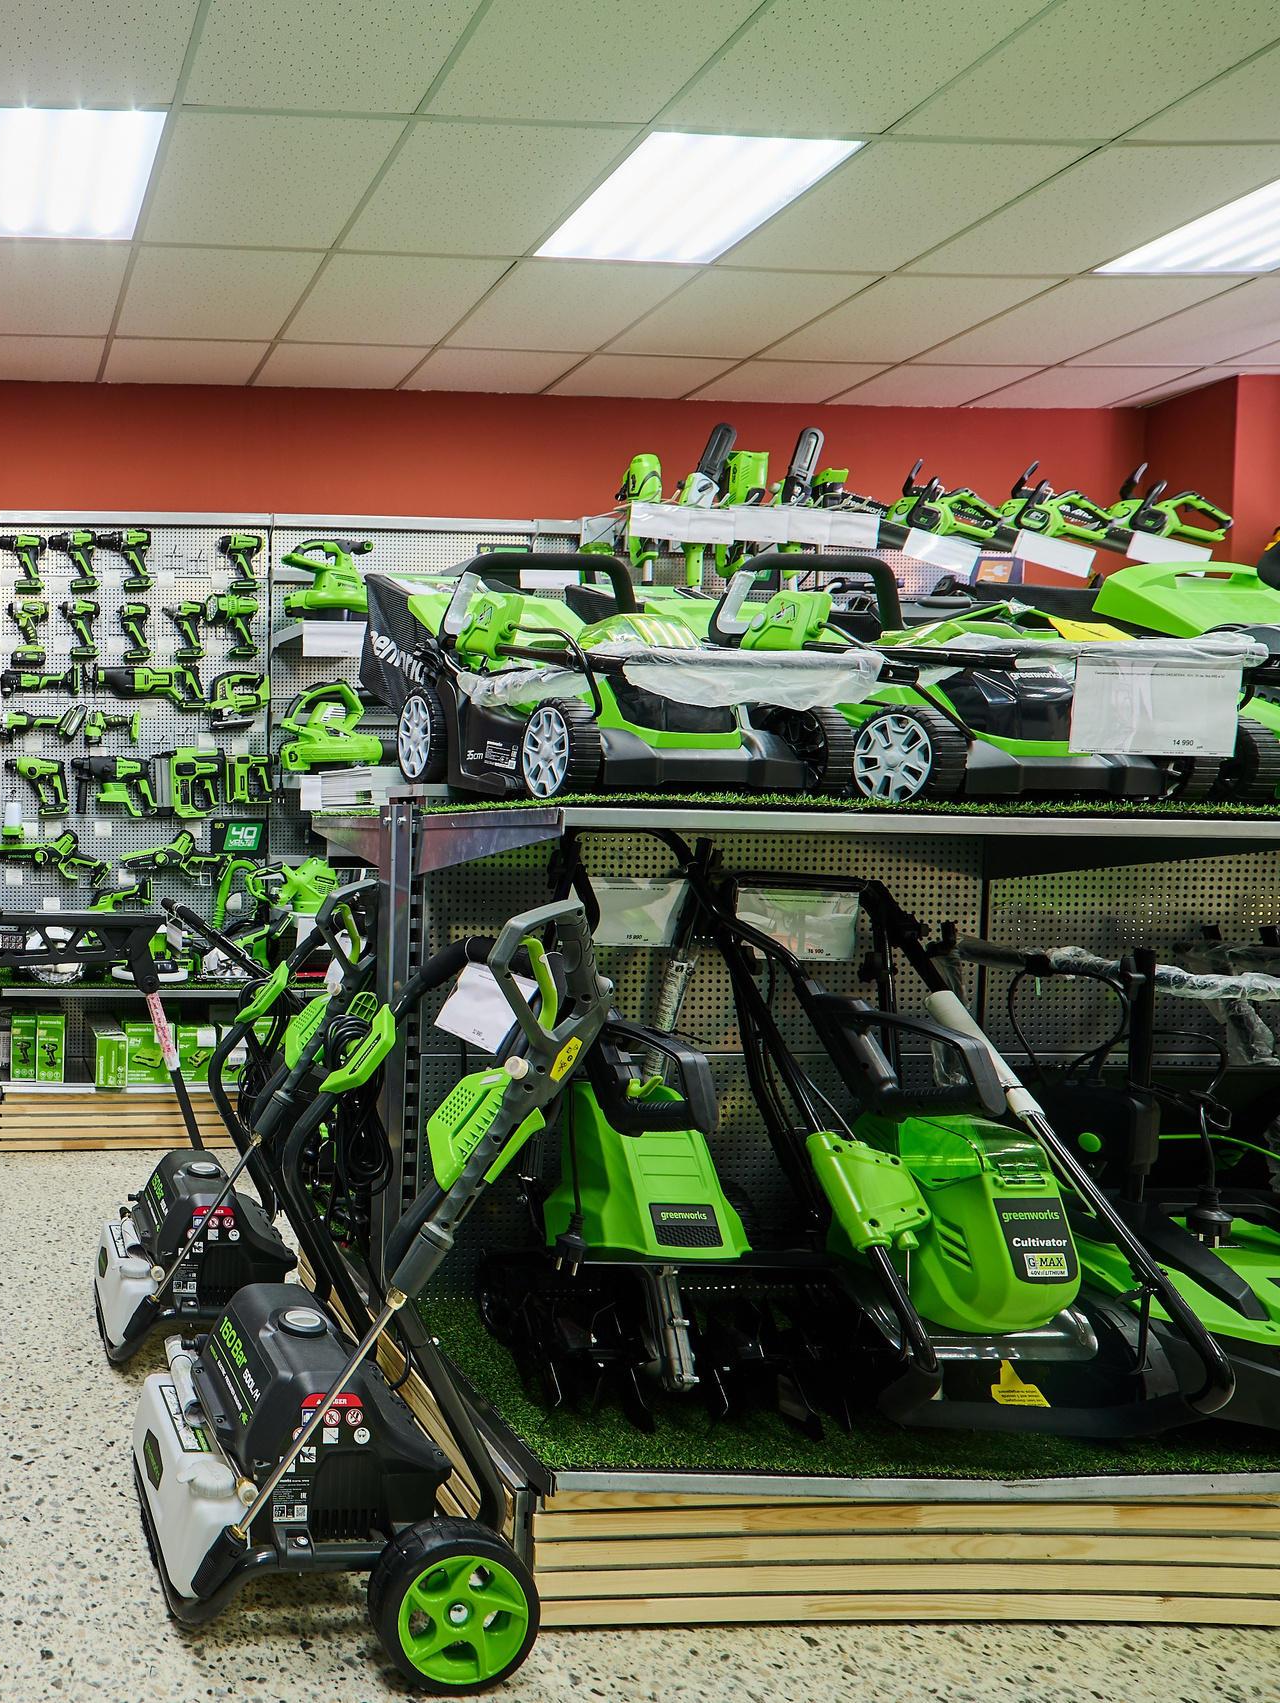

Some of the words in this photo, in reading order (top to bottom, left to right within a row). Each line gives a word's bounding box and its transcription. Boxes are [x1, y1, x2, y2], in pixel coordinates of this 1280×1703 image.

[1009, 670, 1063, 680] greenworks
[231, 826, 258, 839] 40
[660, 1210, 708, 1221] greenworks
[1001, 1209, 1060, 1222] greenworks
[1012, 1237, 1067, 1247] Cultivator
[218, 1315, 236, 1349] 160
[232, 1339, 249, 1369] Bar
